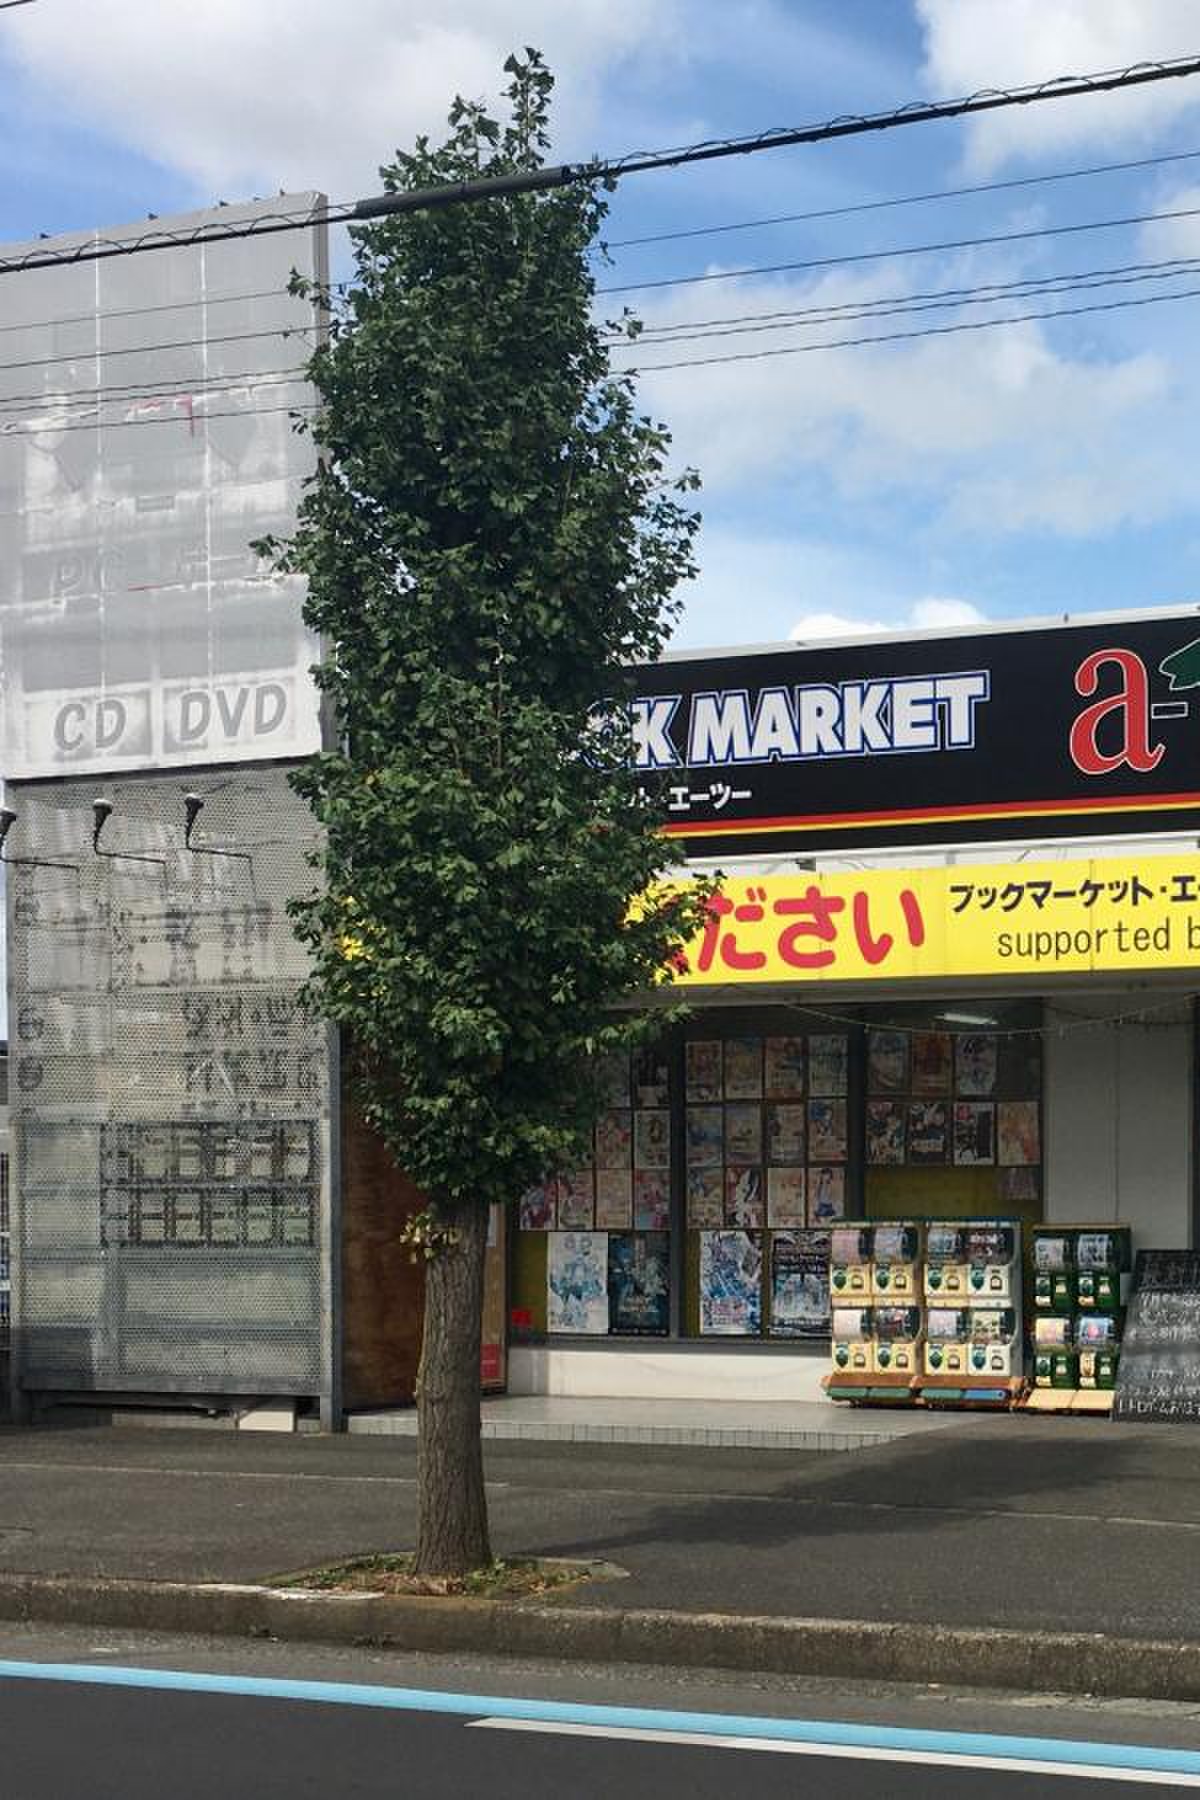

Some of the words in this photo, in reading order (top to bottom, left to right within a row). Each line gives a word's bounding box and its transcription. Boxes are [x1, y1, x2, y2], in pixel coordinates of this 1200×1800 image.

[54, 698, 127, 752] CD
[180, 683, 288, 742] DVD
[687, 670, 990, 768] MARKET
[658, 886, 925, 976] ださい
[998, 916, 1170, 961] supported
